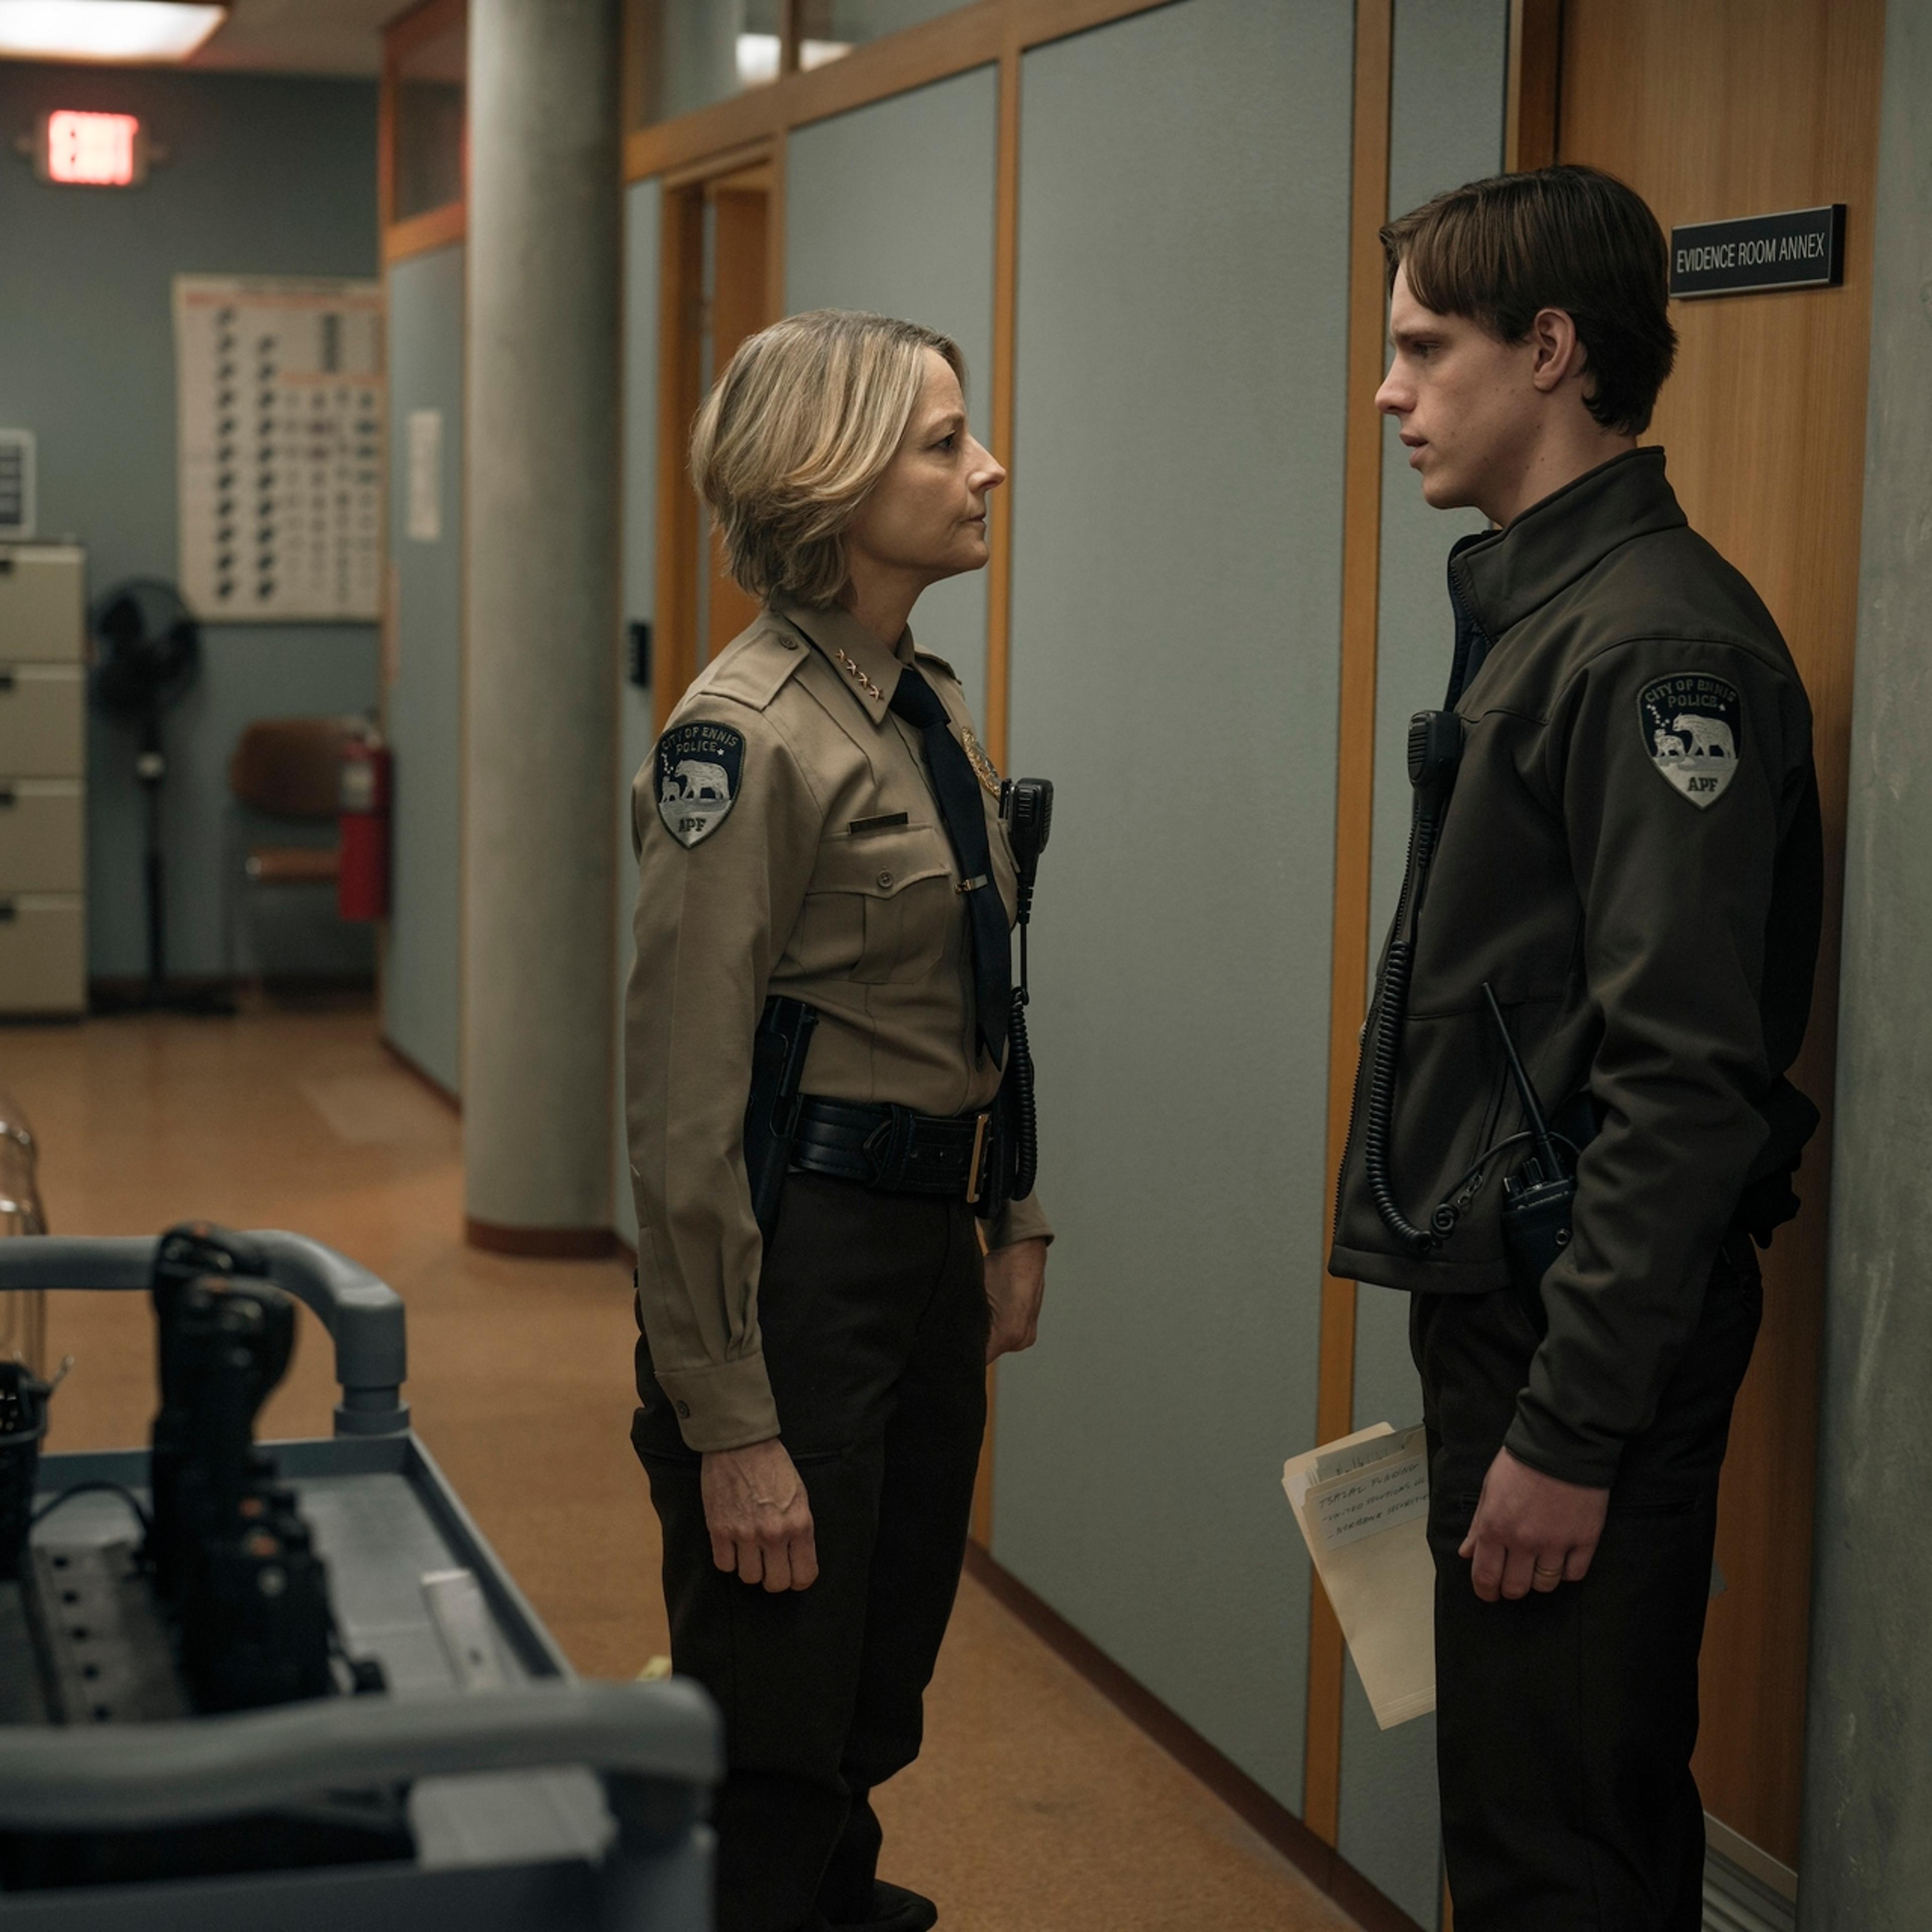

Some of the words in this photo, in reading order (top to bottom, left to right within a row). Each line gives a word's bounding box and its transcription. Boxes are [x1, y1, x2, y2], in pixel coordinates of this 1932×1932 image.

[1676, 244, 1735, 273] EVIDENCE
[1738, 238, 1776, 266] ROOM
[1779, 232, 1825, 262] ANNEX
[1645, 682, 1673, 703] CITY
[1675, 679, 1693, 691] OF
[1667, 694, 1717, 708] POLICE
[685, 727, 700, 739] OF
[702, 727, 739, 747] ENNIS
[676, 741, 717, 755] POLICE
[1687, 777, 1718, 792] APF
